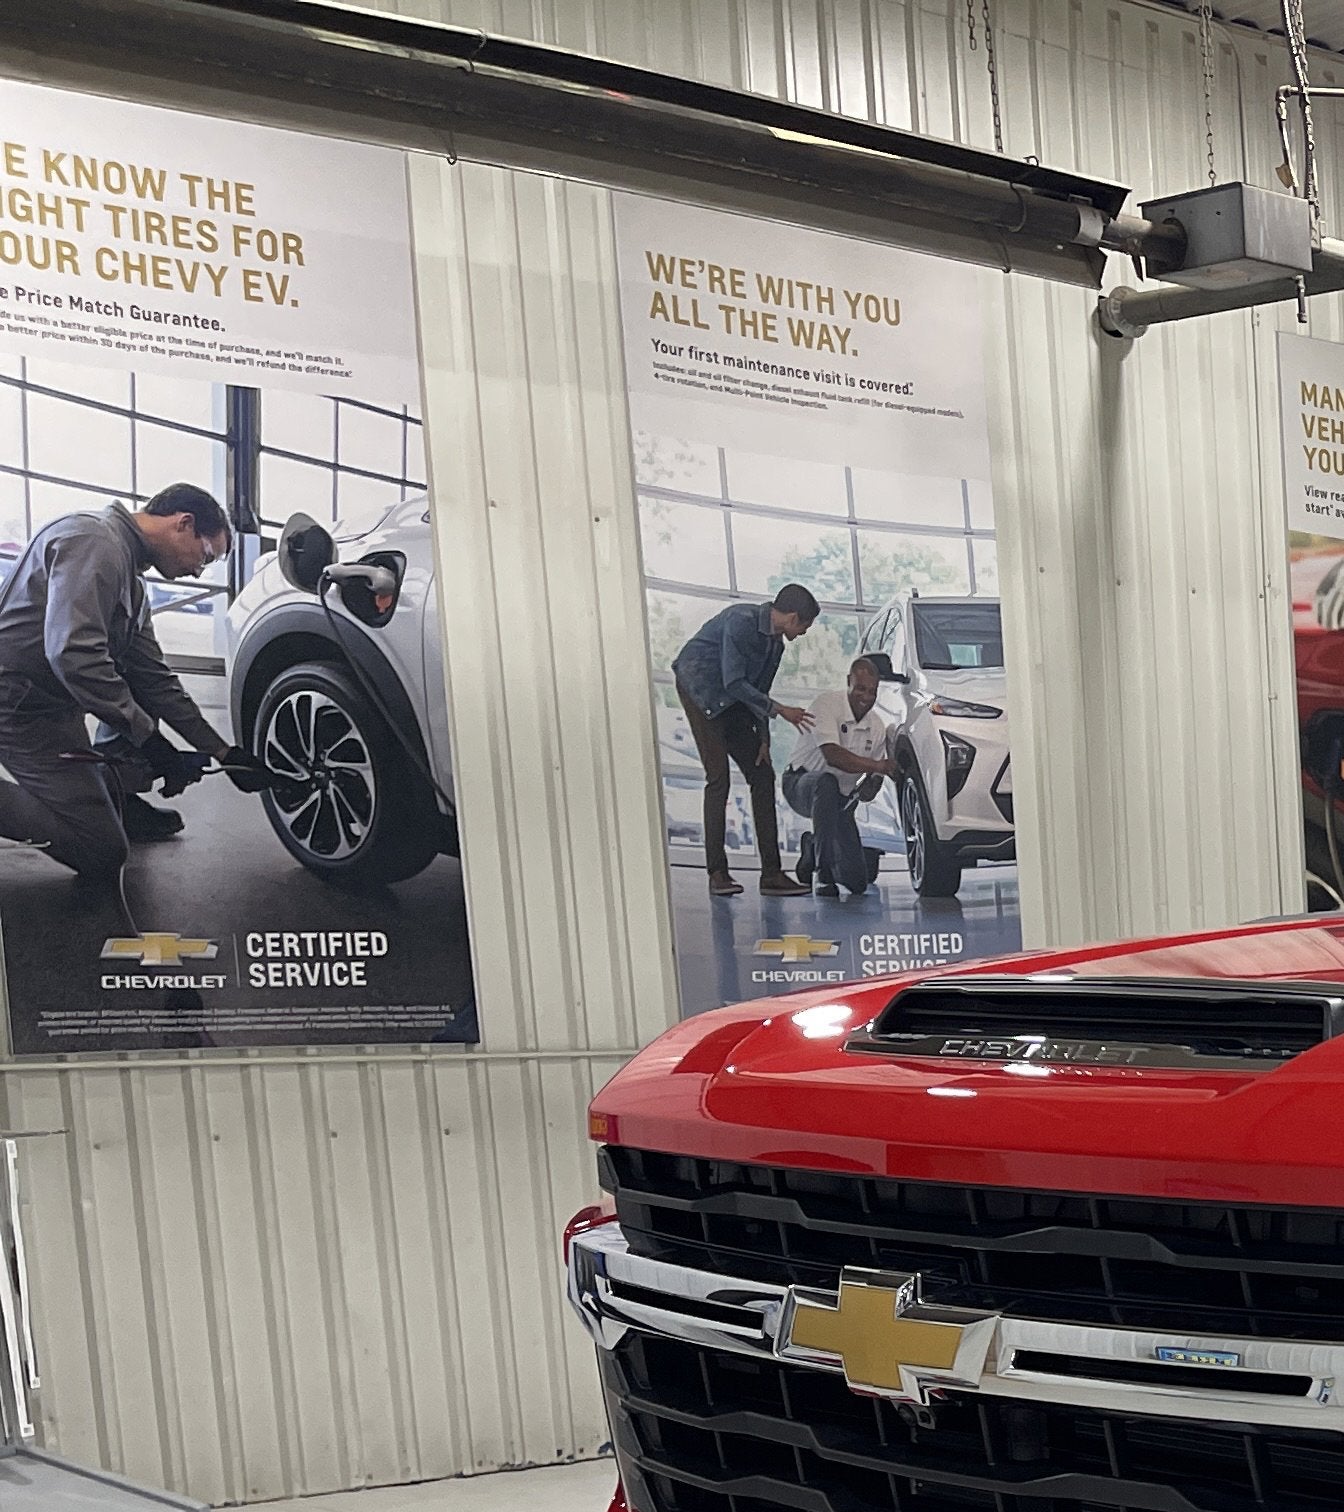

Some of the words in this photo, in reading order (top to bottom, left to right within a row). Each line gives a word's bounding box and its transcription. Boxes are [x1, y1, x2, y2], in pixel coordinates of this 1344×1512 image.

[4, 142, 29, 179] E
[42, 149, 167, 201] KNOW
[180, 173, 257, 217] THE
[0, 186, 91, 233] IGHT
[103, 203, 219, 253] TIRES
[232, 224, 305, 267] FOR
[0, 230, 81, 276] OUR
[95, 247, 229, 297] CHEVY
[243, 269, 299, 308] EV.
[645, 250, 747, 299] WE'RE
[756, 273, 835, 316] WITH
[843, 290, 901, 327] YOU
[14, 286, 63, 309] Price
[69, 296, 125, 319] Match
[130, 305, 226, 332] Guarantee.
[649, 291, 710, 331] ALL
[718, 304, 779, 343] THE
[787, 317, 859, 356] WAY.
[651, 337, 684, 358] Your
[688, 345, 719, 365] first
[723, 353, 810, 381] maintenance
[814, 369, 841, 386] visit
[844, 373, 856, 388] is
[859, 378, 914, 396] covered.
[1304, 485, 1328, 499] View
[1305, 503, 1333, 517] start
[245, 931, 388, 957] CERTIFIED
[859, 932, 963, 955] CERTIFIED
[249, 961, 368, 987] SERVICE
[751, 970, 846, 983] CHEVROLET
[862, 959, 947, 978] SERV
[101, 974, 227, 990] CHEVROLET
